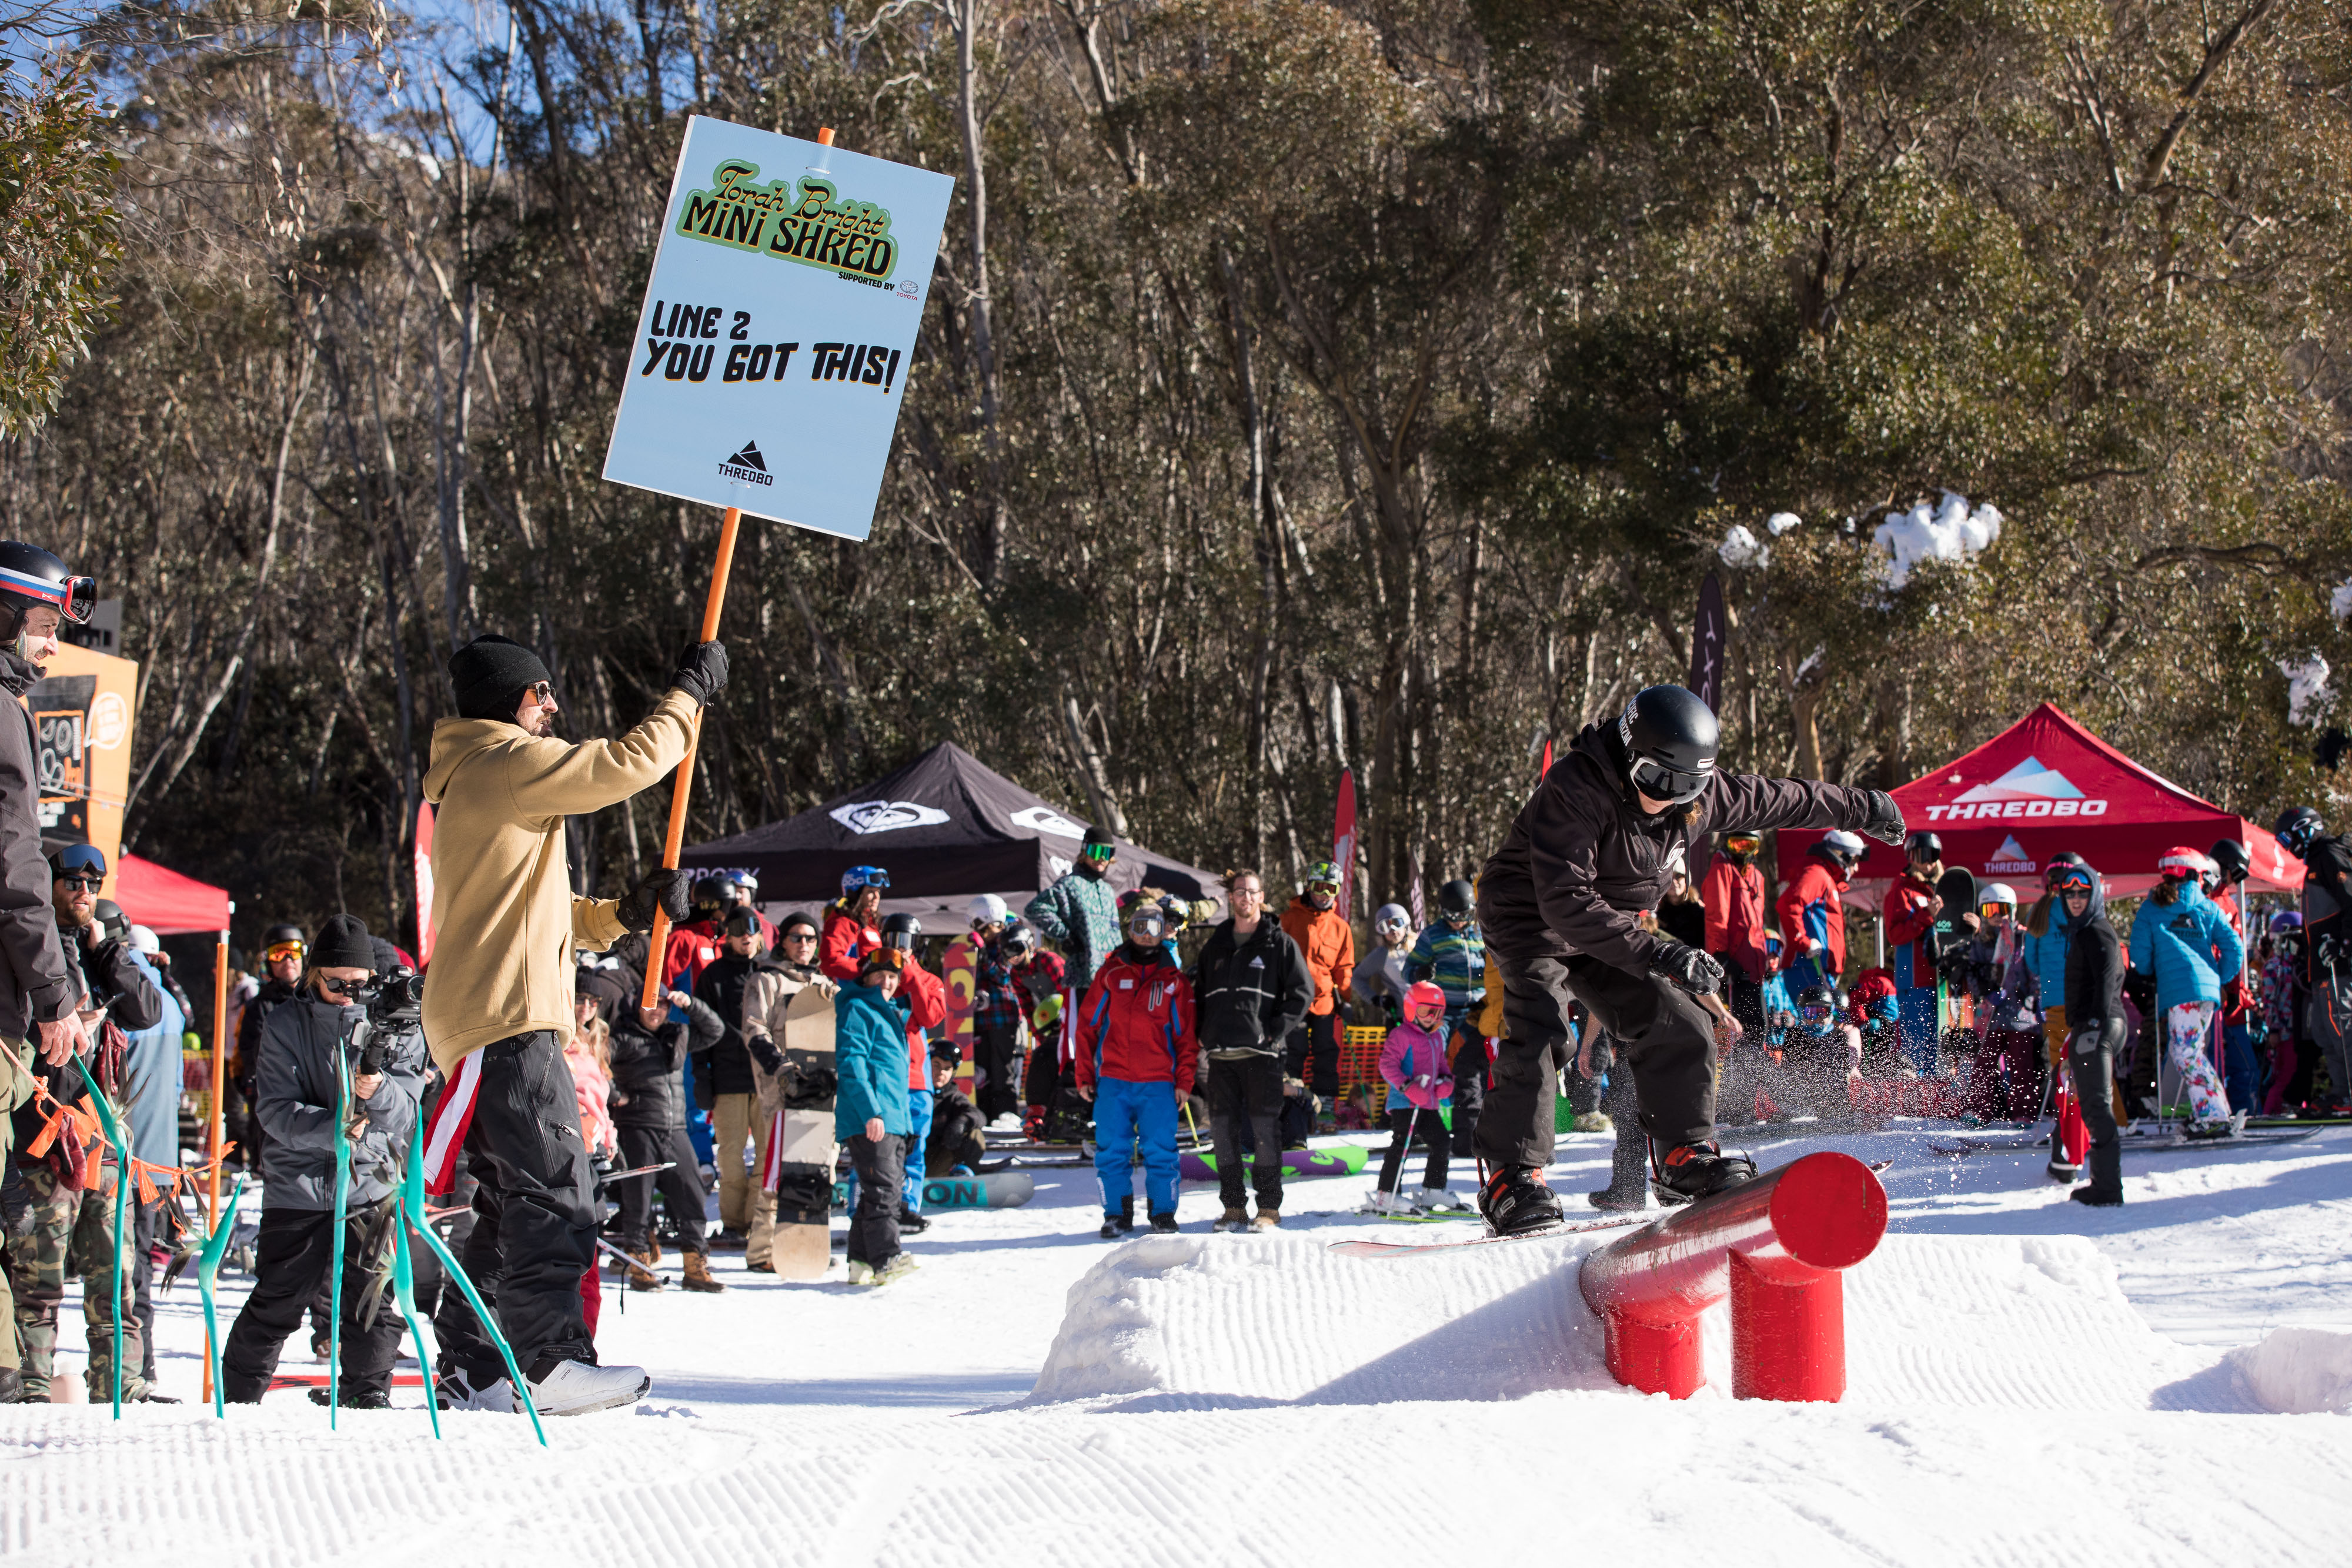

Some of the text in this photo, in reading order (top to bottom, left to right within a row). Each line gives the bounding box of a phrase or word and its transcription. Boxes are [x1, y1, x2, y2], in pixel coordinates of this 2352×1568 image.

[714, 165, 885, 239] Torah Bright
[769, 217, 893, 277] SHRED
[838, 271, 896, 291] SUPPORTED BY
[896, 292, 918, 301] TOYOTA
[651, 300, 751, 340] LINE 2
[642, 337, 901, 395] YOU GOT THIS!
[718, 463, 773, 486] THREDBO
[1925, 800, 2108, 821] THREDBO
[1984, 860, 2036, 874] THREDBO
